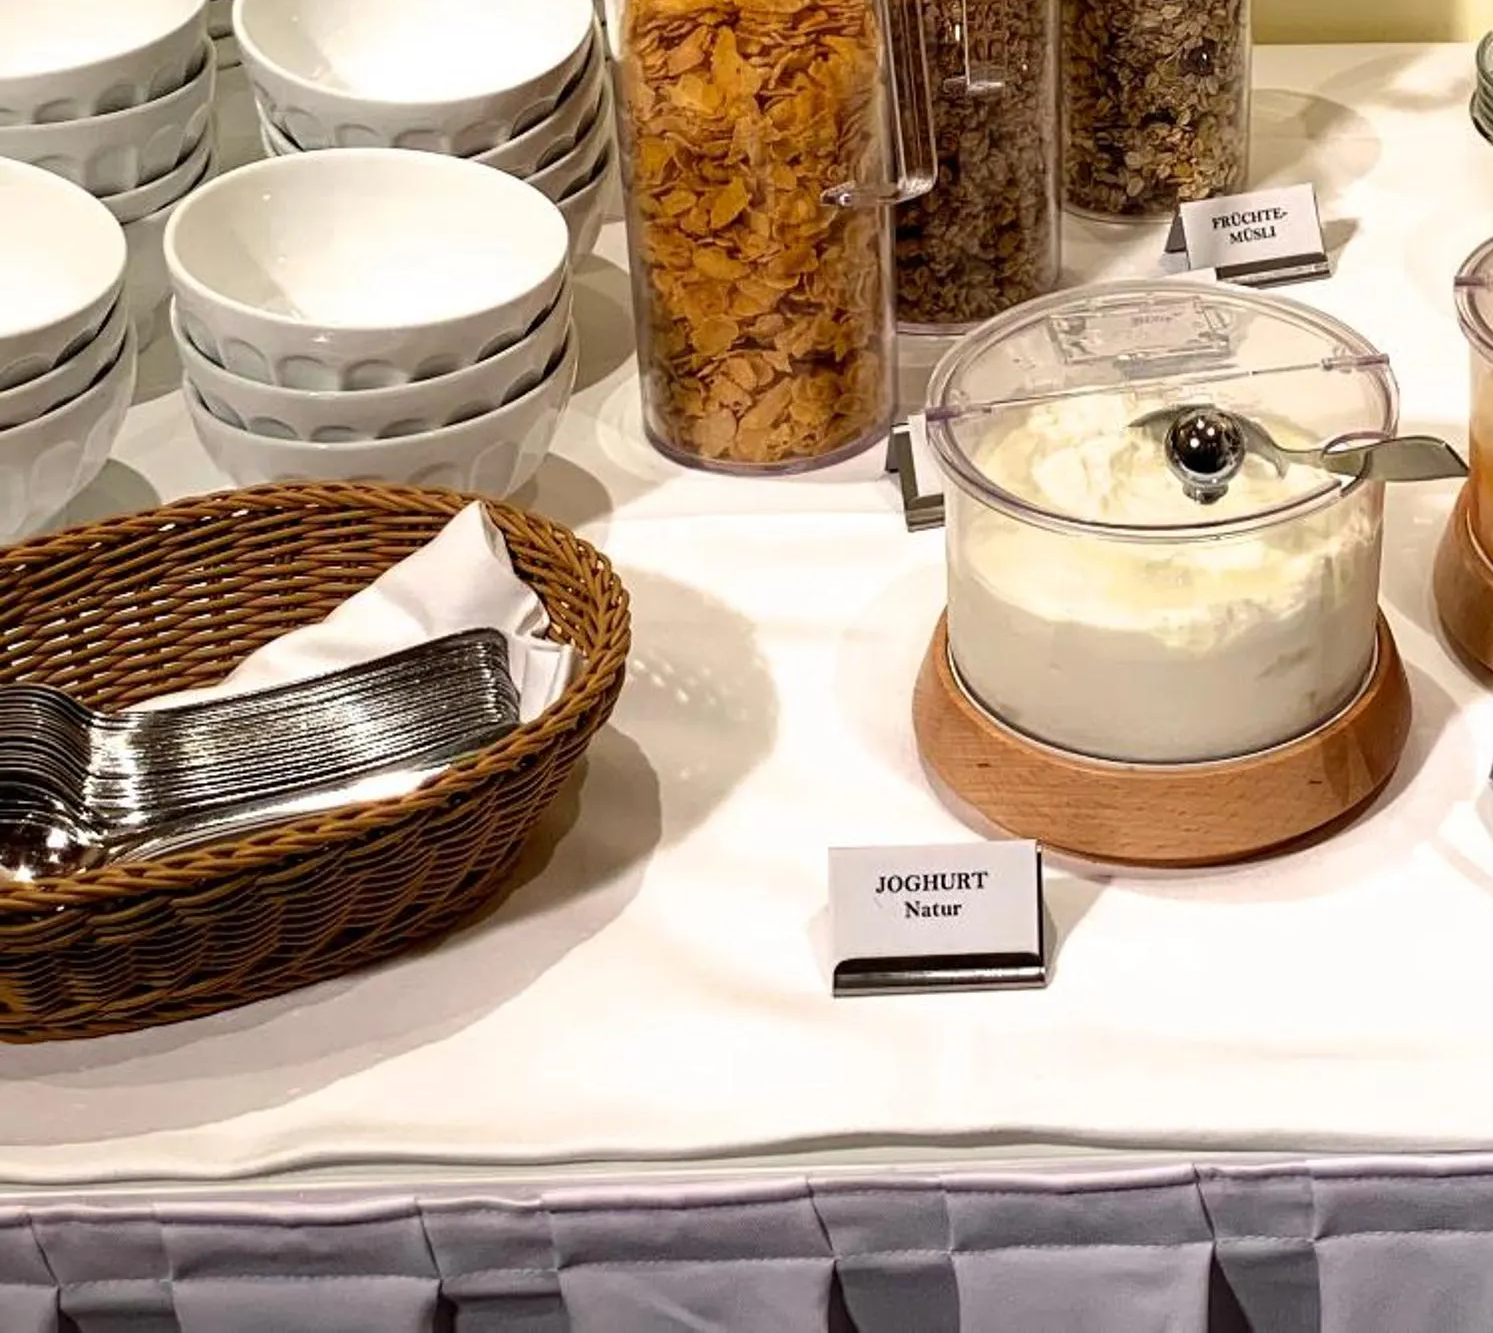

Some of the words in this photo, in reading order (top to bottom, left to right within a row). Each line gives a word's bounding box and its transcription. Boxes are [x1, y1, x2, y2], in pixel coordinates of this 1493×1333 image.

[1212, 207, 1288, 230] FRÜCHTE-
[1229, 225, 1277, 245] MÜSLI
[875, 871, 988, 894] JOGHURT
[904, 900, 962, 918] Natur
